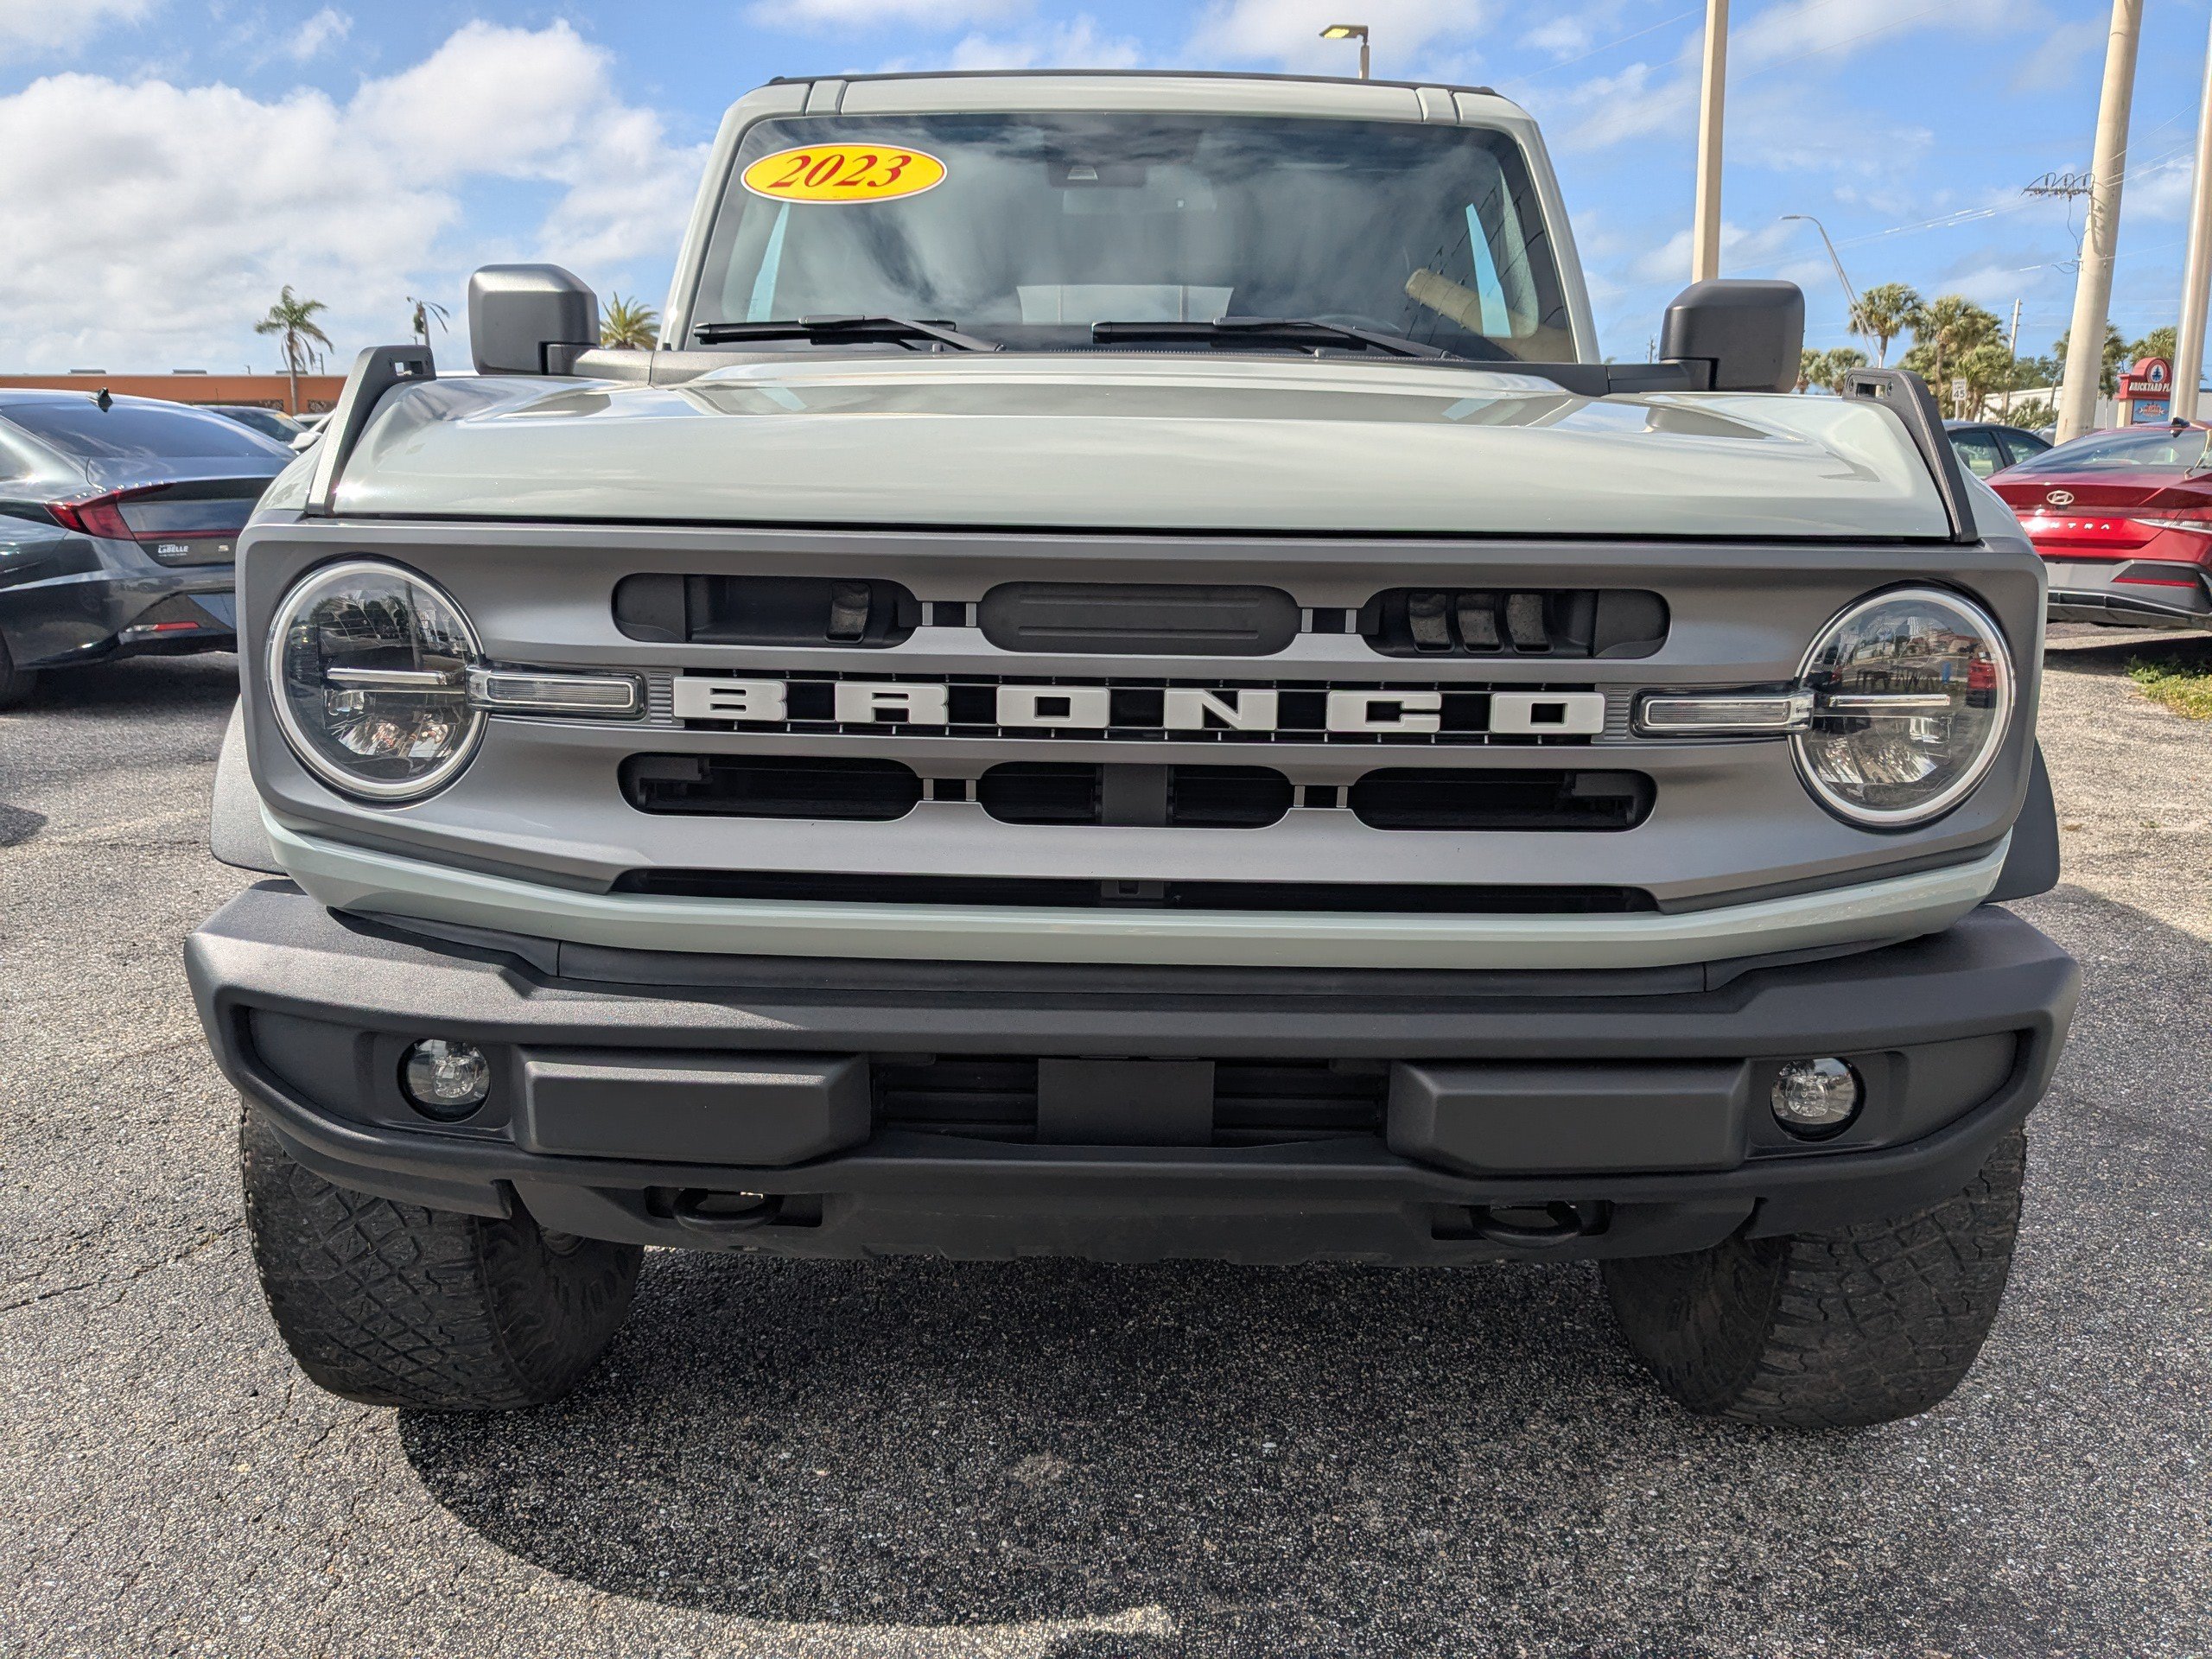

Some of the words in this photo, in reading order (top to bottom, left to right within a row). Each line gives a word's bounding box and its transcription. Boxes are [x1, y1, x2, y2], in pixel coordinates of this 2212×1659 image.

[767, 154, 912, 188] 2023
[1954, 390, 1965, 398] 45
[2129, 382, 2163, 391] BRICKYARD
[674, 676, 1605, 734] BRONCO
